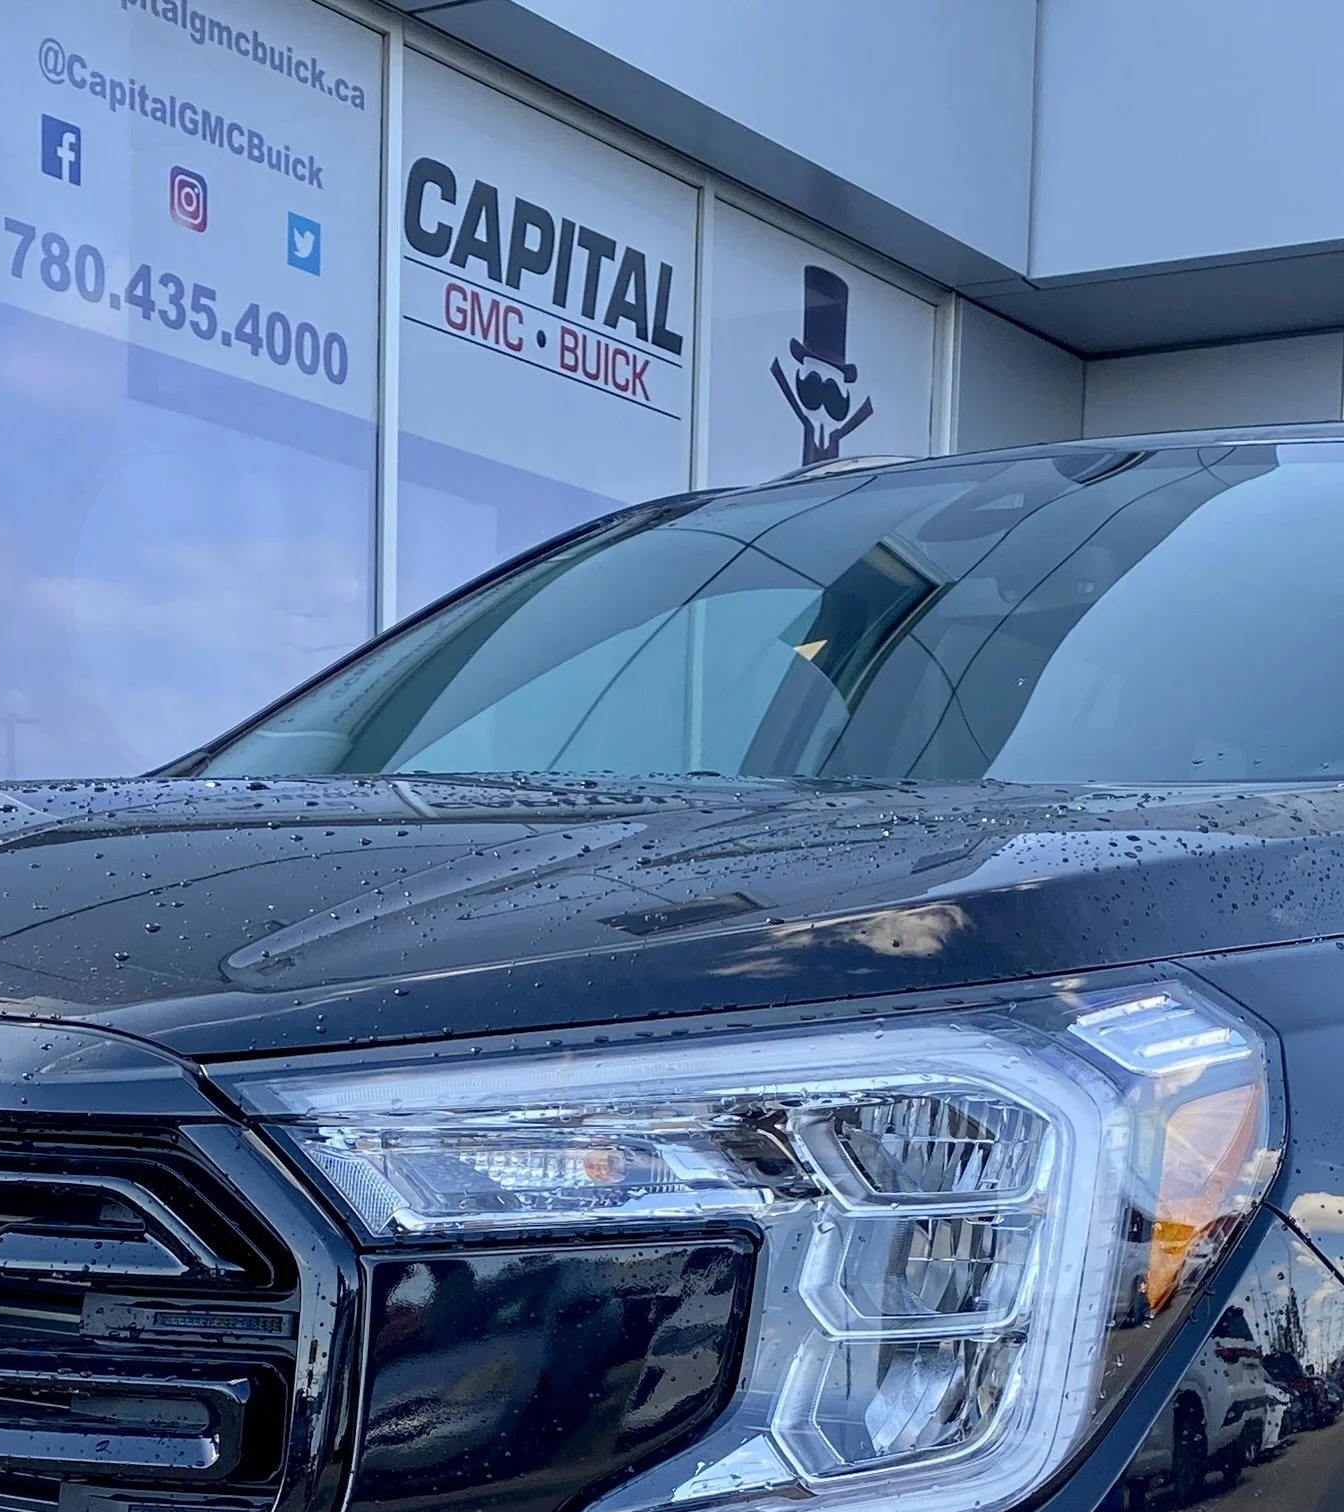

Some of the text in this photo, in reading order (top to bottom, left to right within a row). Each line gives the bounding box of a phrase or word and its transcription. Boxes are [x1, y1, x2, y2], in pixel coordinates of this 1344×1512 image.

[39, 37, 324, 190] @CapitalGMCBuick
[4, 216, 348, 385] 780.435.4000
[404, 157, 684, 356] CAPITAL
[444, 282, 651, 402] GMC BUICK
